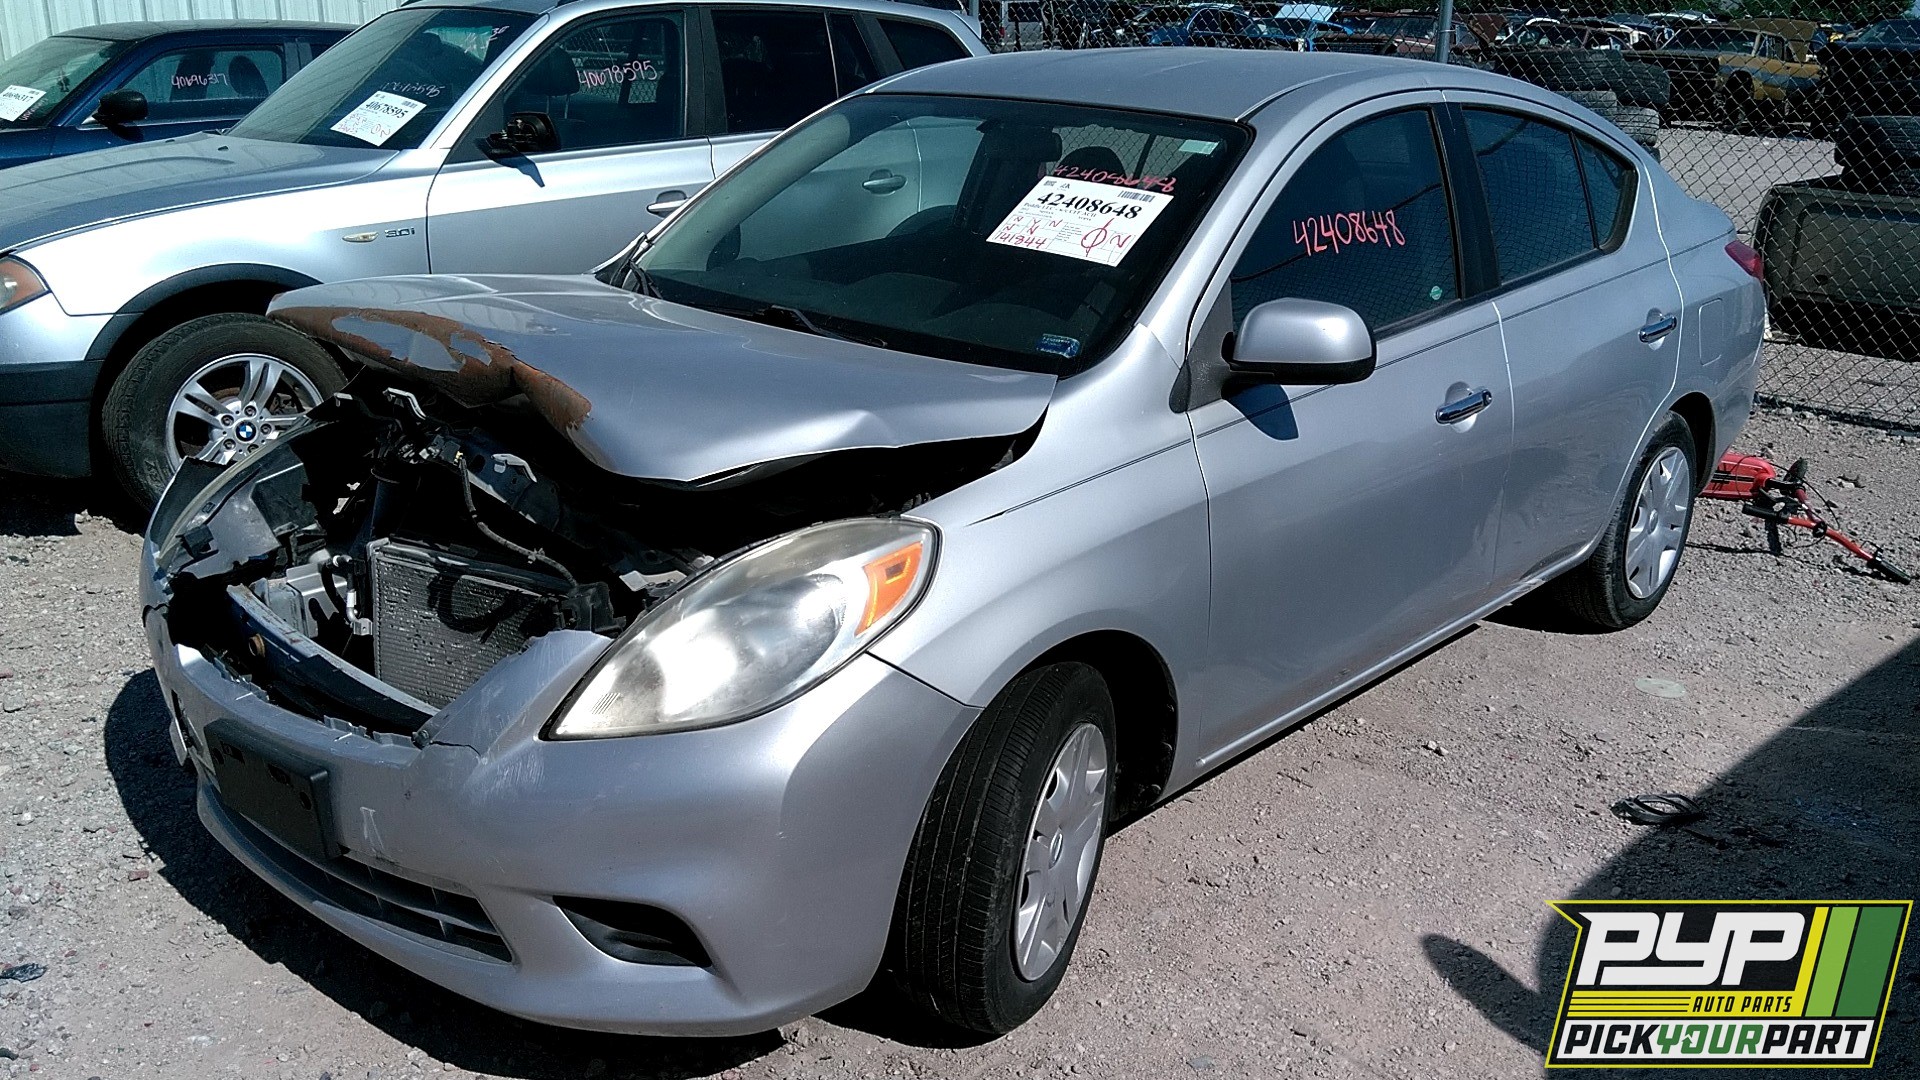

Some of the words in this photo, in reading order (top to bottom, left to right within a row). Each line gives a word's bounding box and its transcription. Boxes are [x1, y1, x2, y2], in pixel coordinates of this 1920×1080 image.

[171, 73, 228, 89] 40696317
[576, 59, 658, 88] 40678595
[1037, 192, 1142, 219] 42408648
[1293, 209, 1406, 256] 42408648
